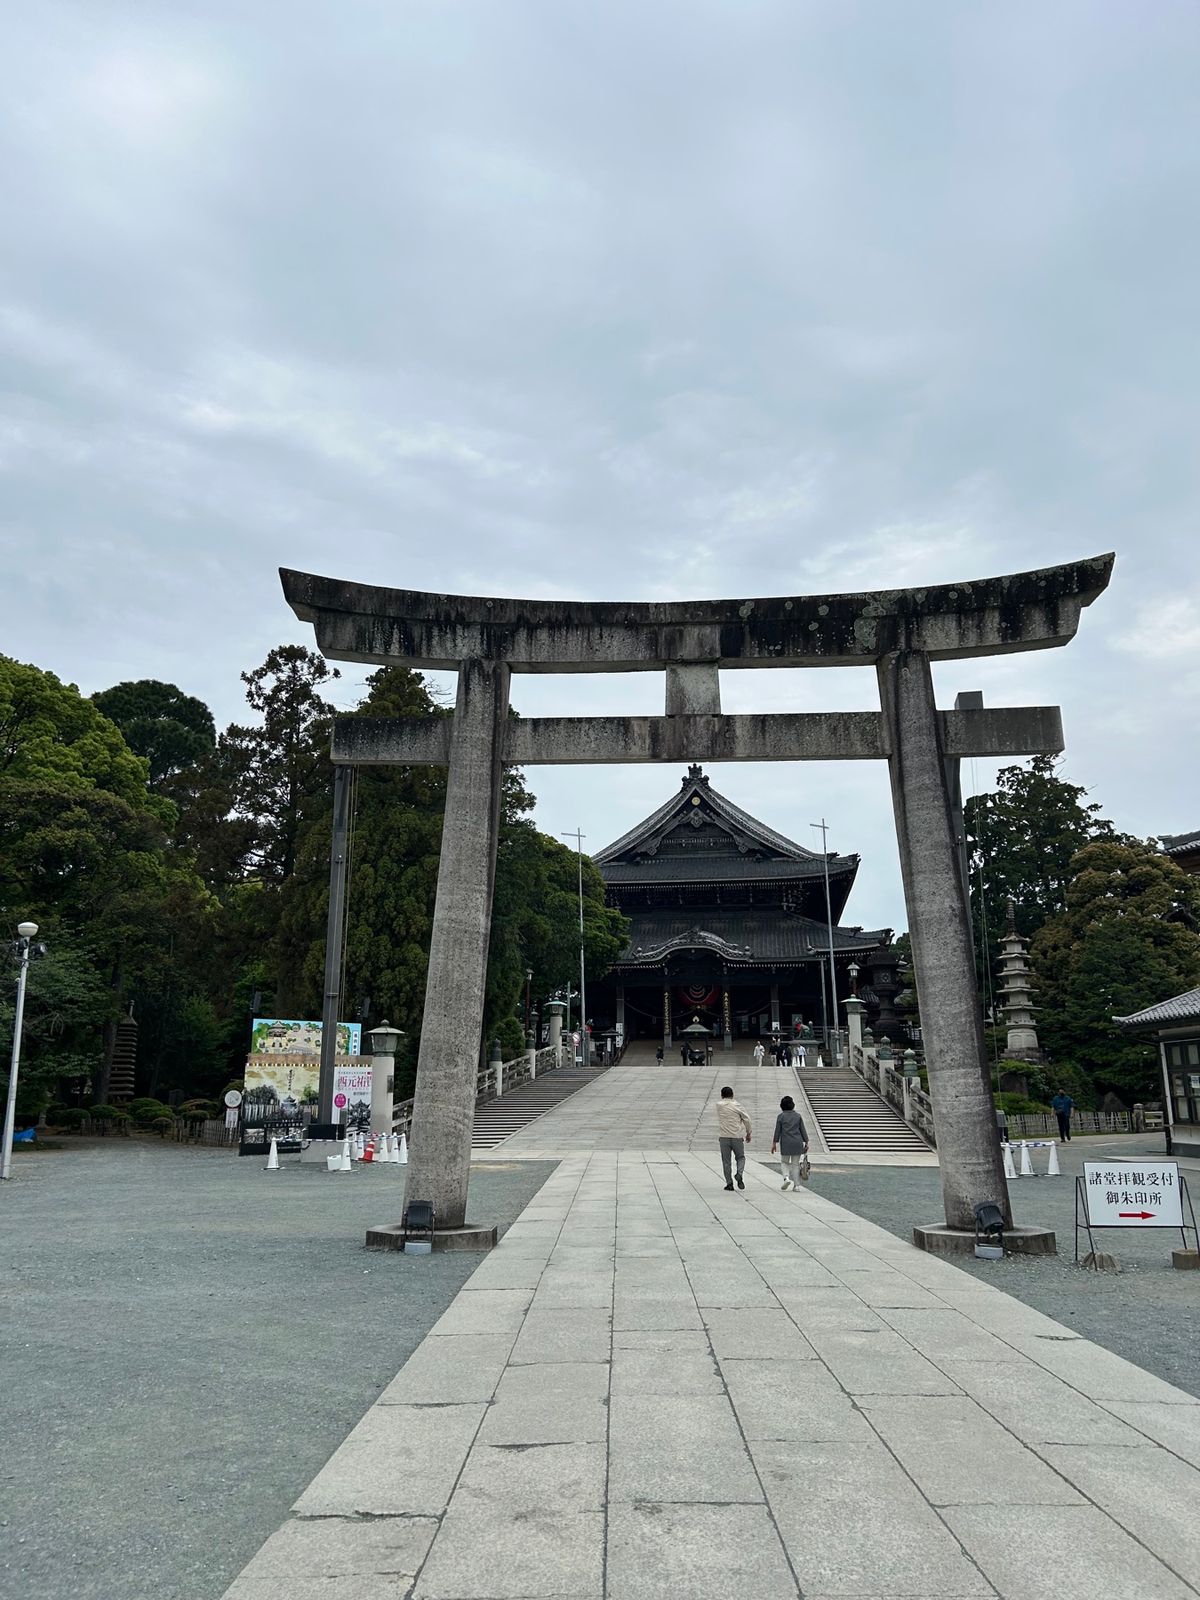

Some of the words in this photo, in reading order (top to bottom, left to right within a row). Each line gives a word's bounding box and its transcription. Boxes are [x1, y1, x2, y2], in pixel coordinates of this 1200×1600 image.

[1089, 1171, 1174, 1186] 諸堂拝観受付
[1106, 1191, 1162, 1205] 御朱印所
